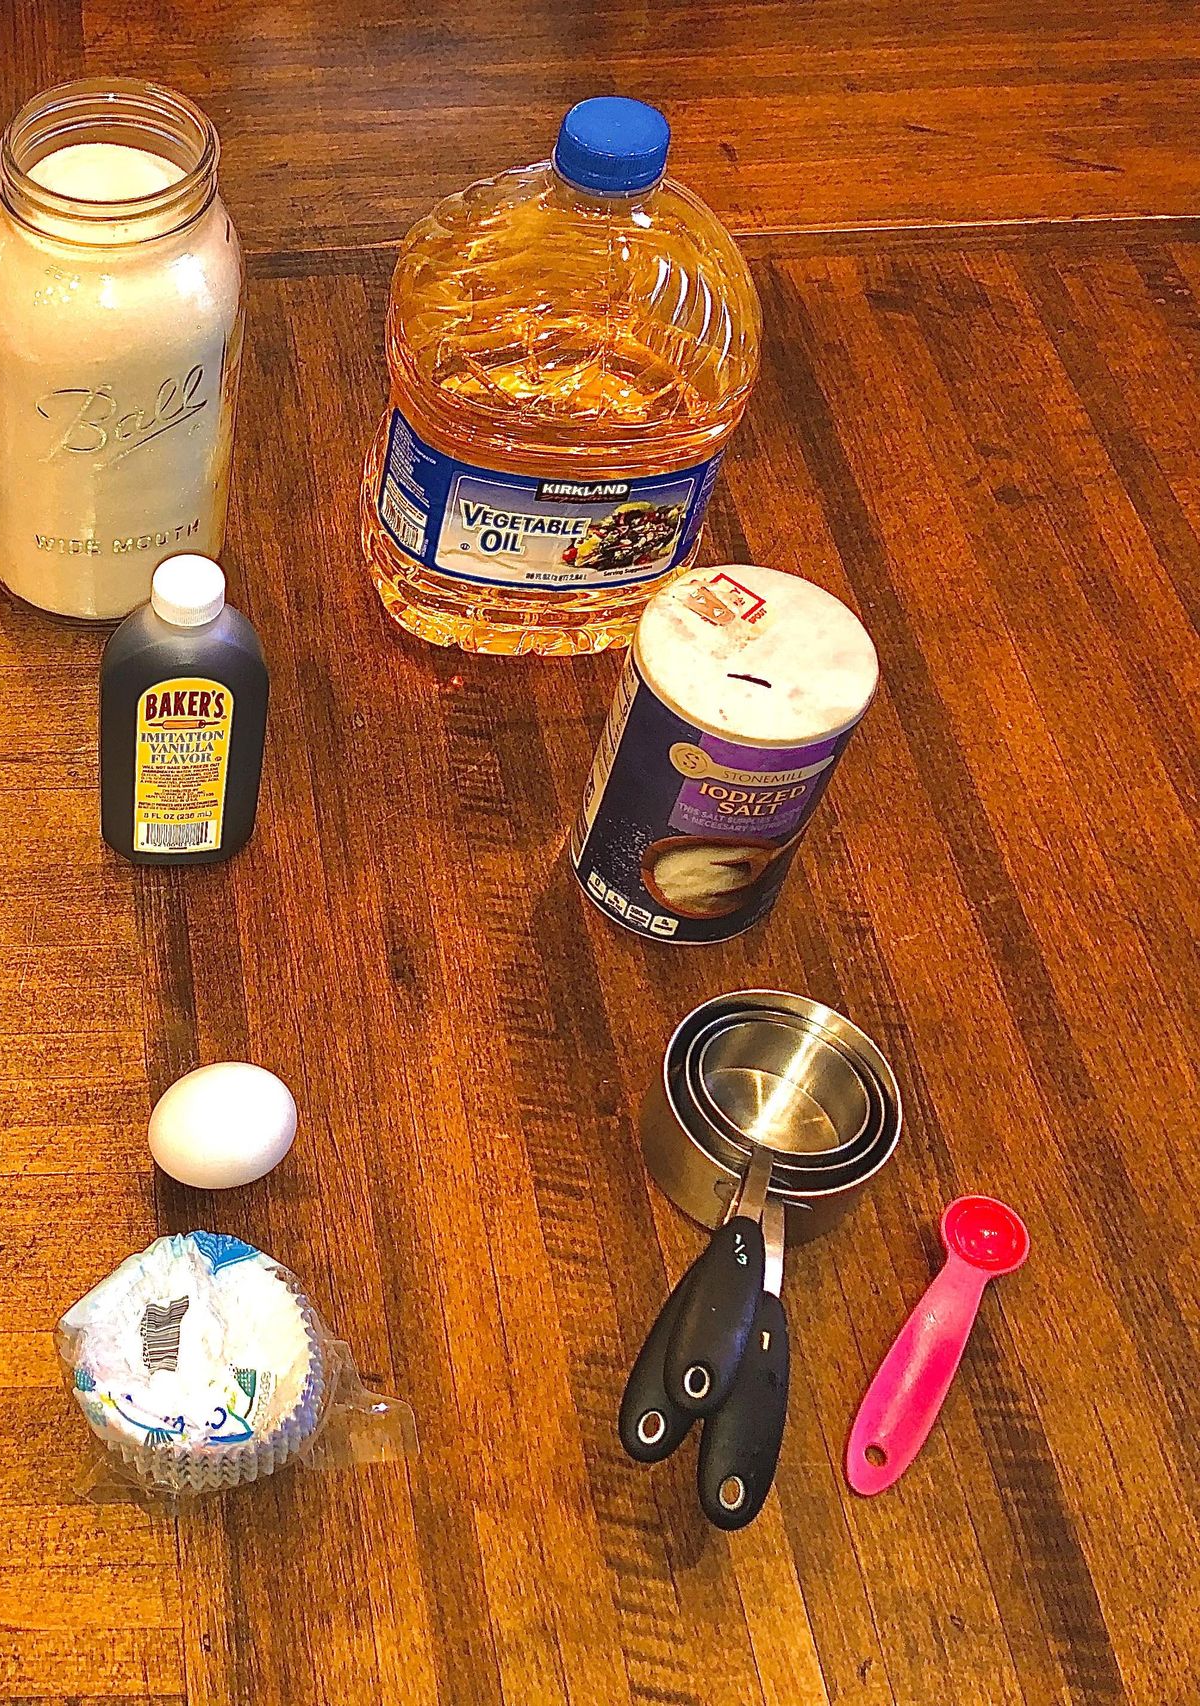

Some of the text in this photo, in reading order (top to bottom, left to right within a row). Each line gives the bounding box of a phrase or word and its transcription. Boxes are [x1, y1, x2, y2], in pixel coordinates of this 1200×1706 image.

[36, 364, 208, 464] Ball
[542, 483, 628, 496] KIRKLAND
[461, 501, 587, 535] VEGETABLE
[35, 518, 201, 555] WIDE MOUTH
[480, 530, 522, 553] OIL
[145, 690, 224, 721] BAKER'S
[141, 730, 224, 743] IMITATION
[150, 742, 214, 754] VANILLA
[151, 752, 212, 764] FLAVOR
[723, 770, 802, 783] STONEMILL
[699, 783, 806, 804] IODIZED
[679, 802, 698, 815] THIS
[701, 811, 726, 821] SALT
[718, 802, 782, 816] SALT
[692, 816, 747, 832] NECESSARY
[734, 1234, 748, 1265] 1/3
[762, 1332, 770, 1350] 1
